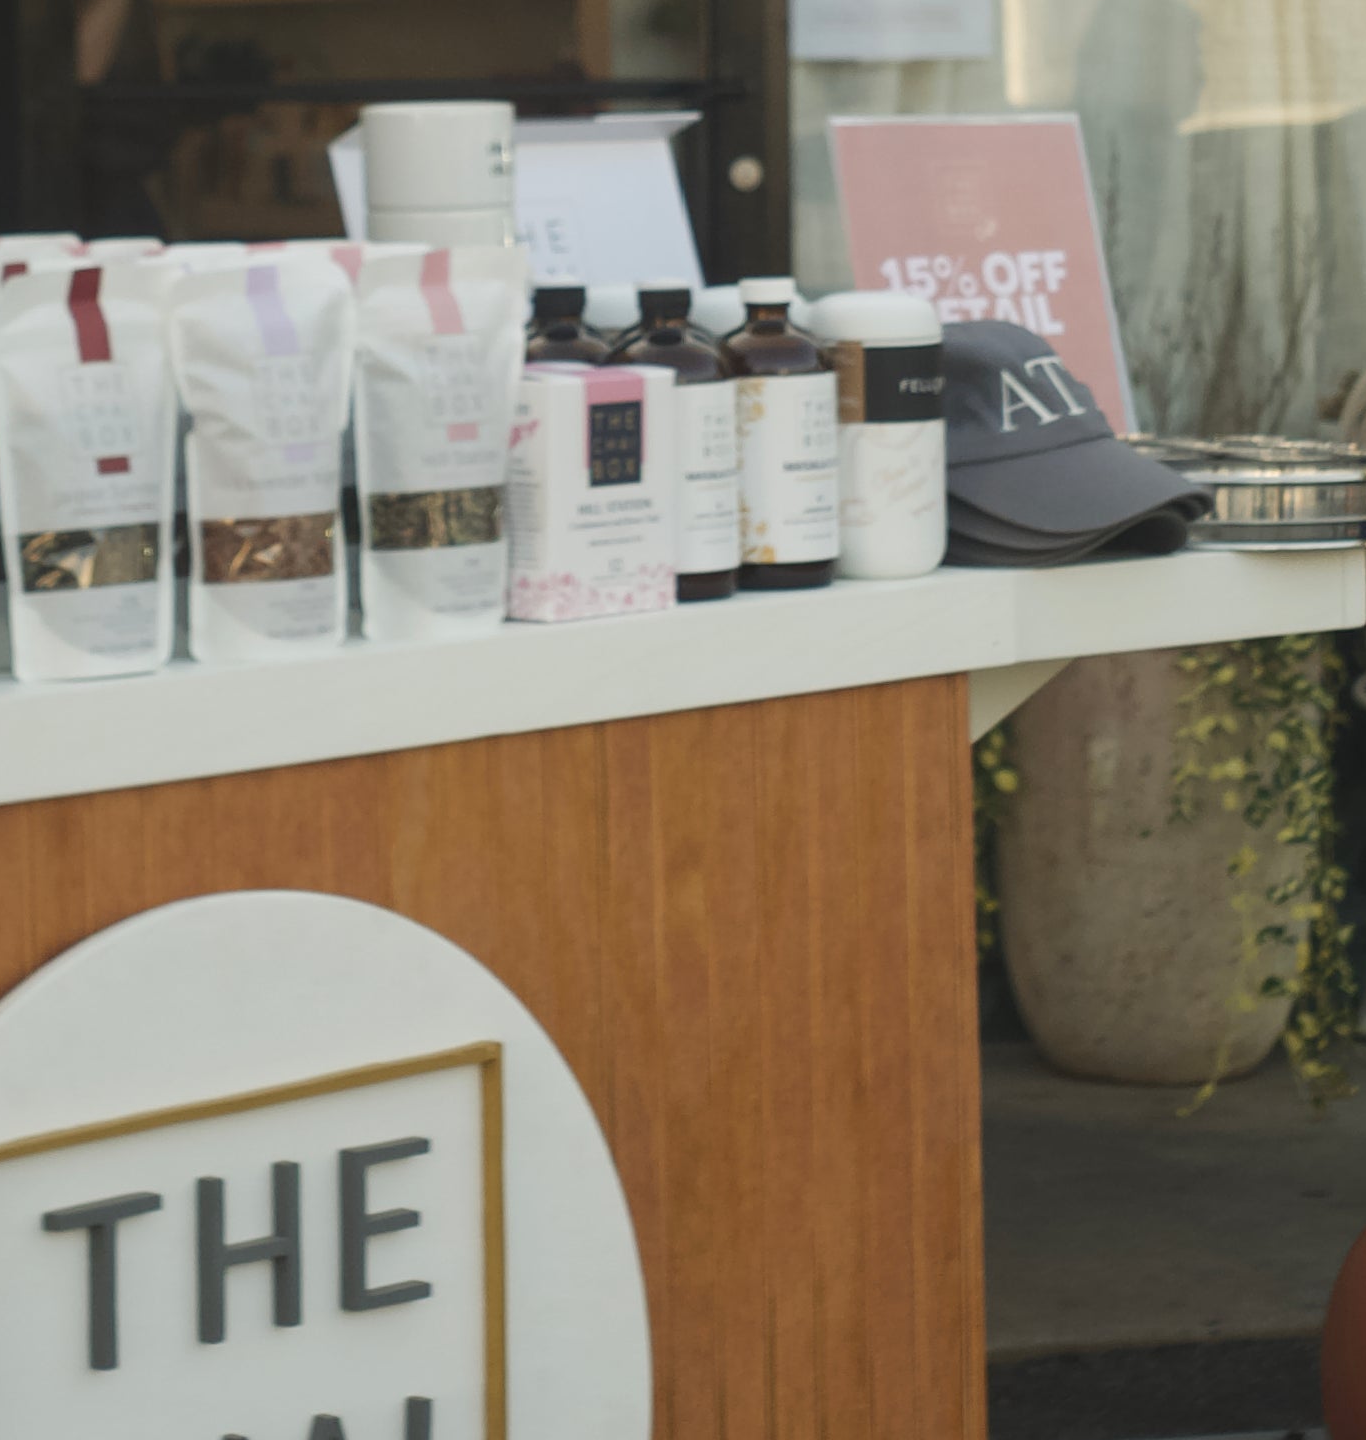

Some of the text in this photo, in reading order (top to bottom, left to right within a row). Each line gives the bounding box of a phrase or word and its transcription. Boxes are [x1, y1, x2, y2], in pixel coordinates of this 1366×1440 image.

[517, 220, 569, 255] HE
[878, 249, 1067, 301] 15% OFF
[937, 290, 1066, 336] ETAIL
[1000, 355, 1087, 433] AT
[42, 1136, 433, 1371] THE
